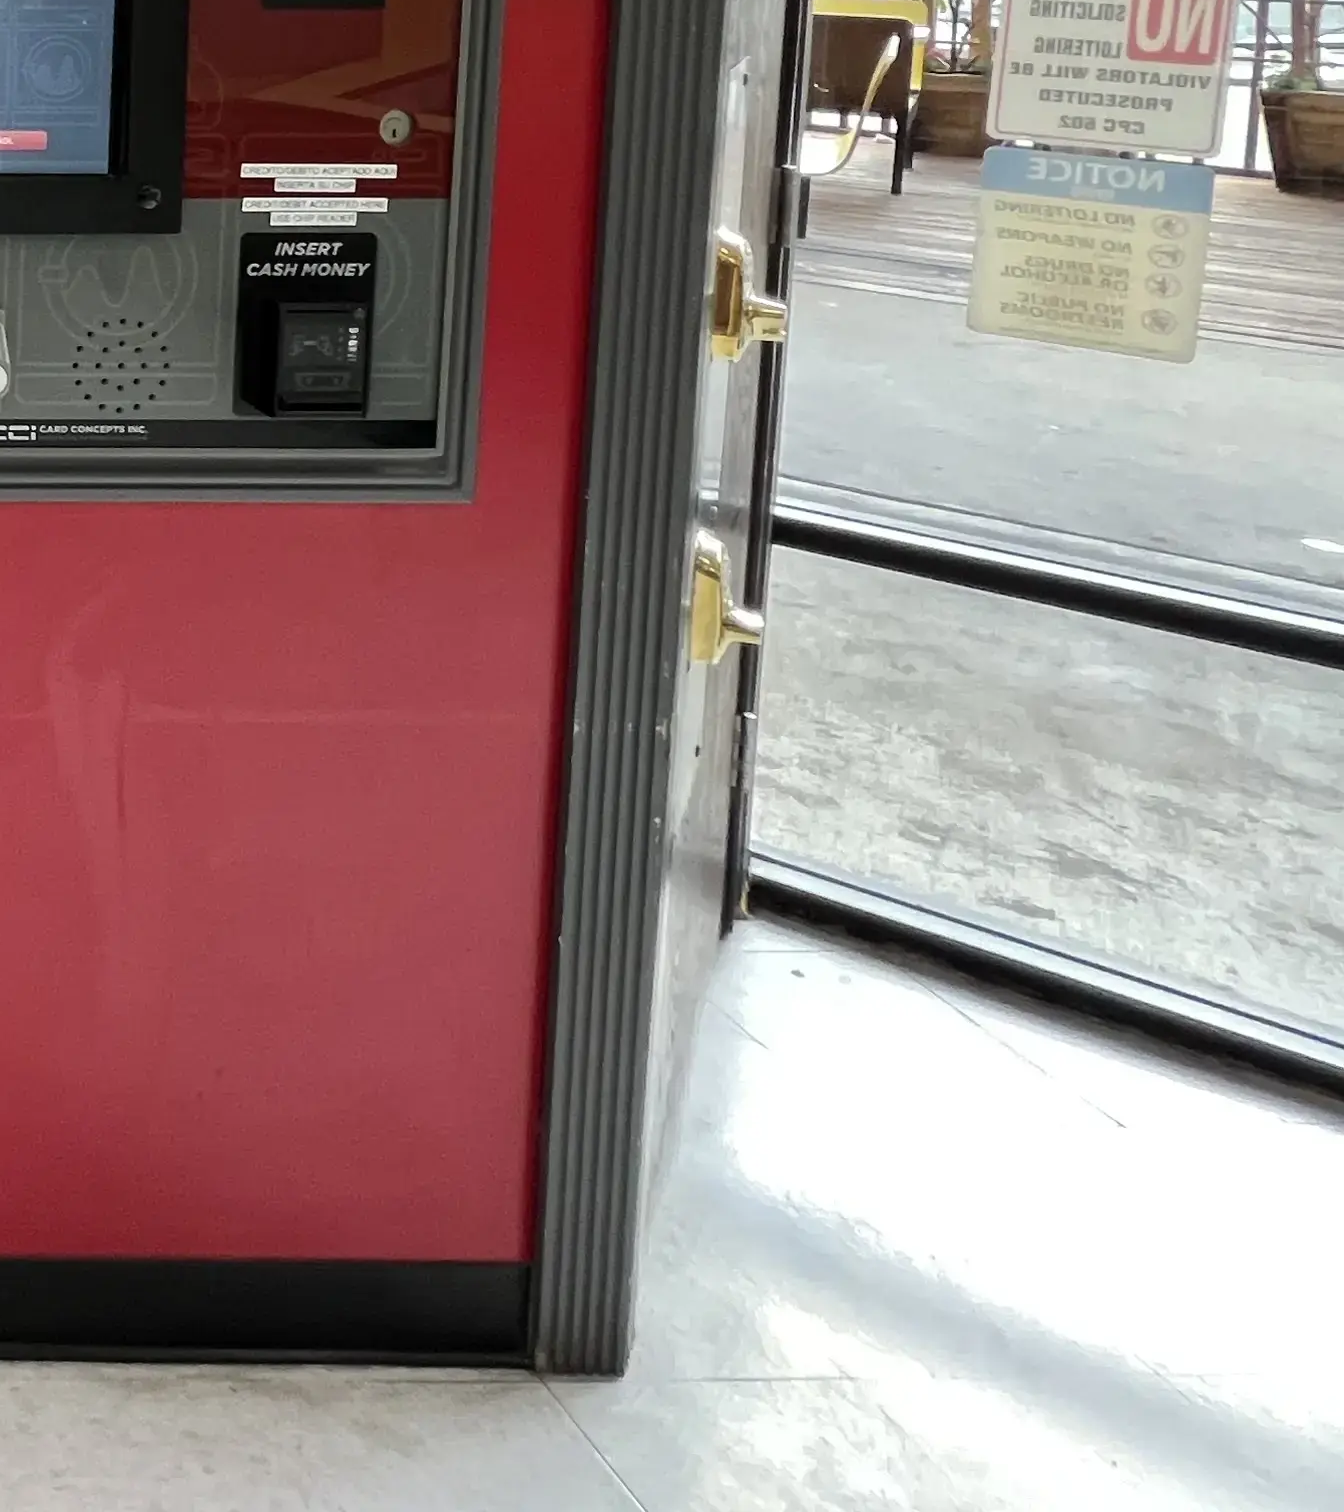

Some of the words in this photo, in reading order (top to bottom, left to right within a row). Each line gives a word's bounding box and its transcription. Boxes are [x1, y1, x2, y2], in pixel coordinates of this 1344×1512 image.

[275, 242, 343, 256] INSERT
[247, 263, 298, 276] CASH
[301, 263, 370, 276] MONEY
[40, 425, 68, 434] CARD
[70, 425, 125, 434] CONCEPTS
[128, 425, 148, 434] INC.
